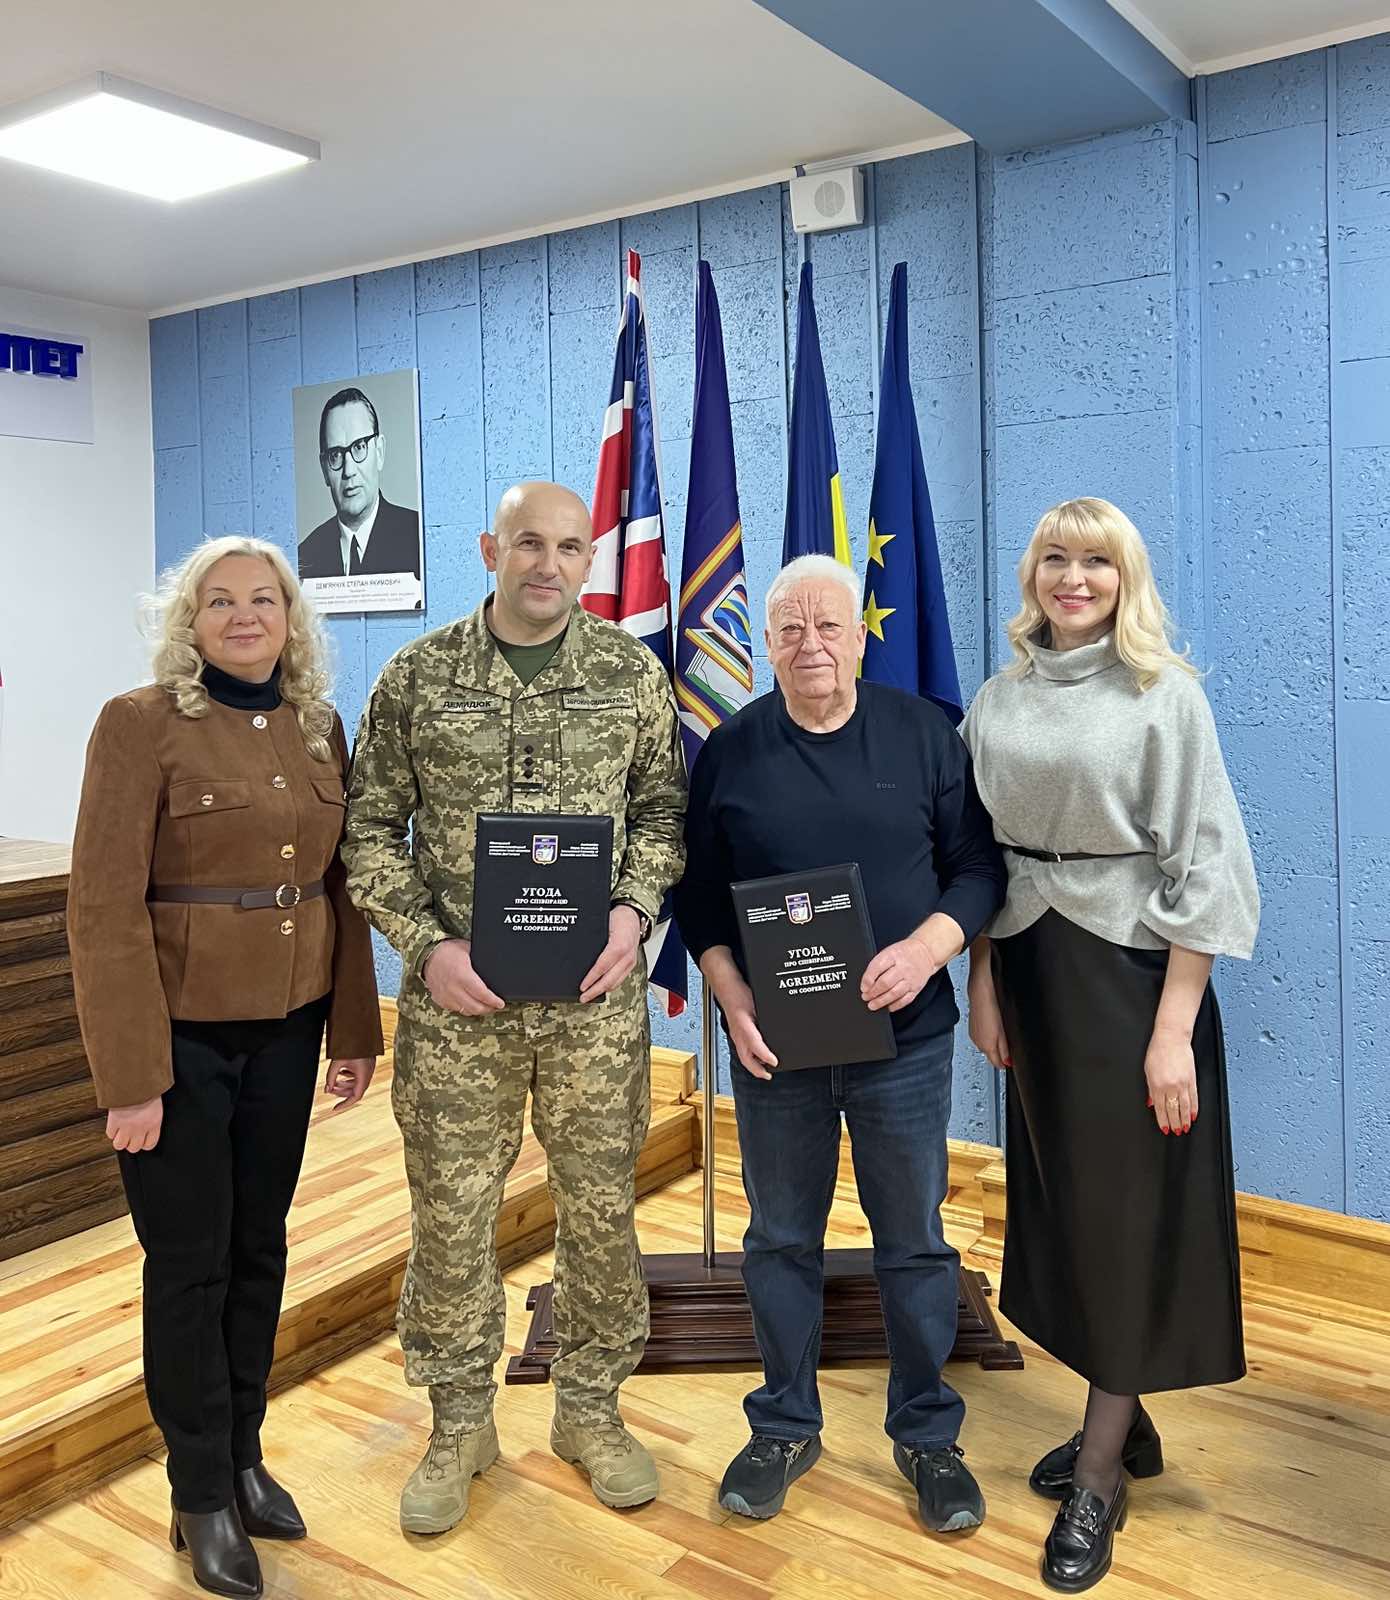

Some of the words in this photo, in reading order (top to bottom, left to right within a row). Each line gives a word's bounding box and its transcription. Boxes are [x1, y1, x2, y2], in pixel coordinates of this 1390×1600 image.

[522, 887, 562, 898] УГОДА
[504, 914, 578, 924] AGREEMENT
[787, 945, 827, 959] УГОДА
[779, 970, 848, 989] AGREEMENT
[799, 983, 841, 994] COOPERATION
